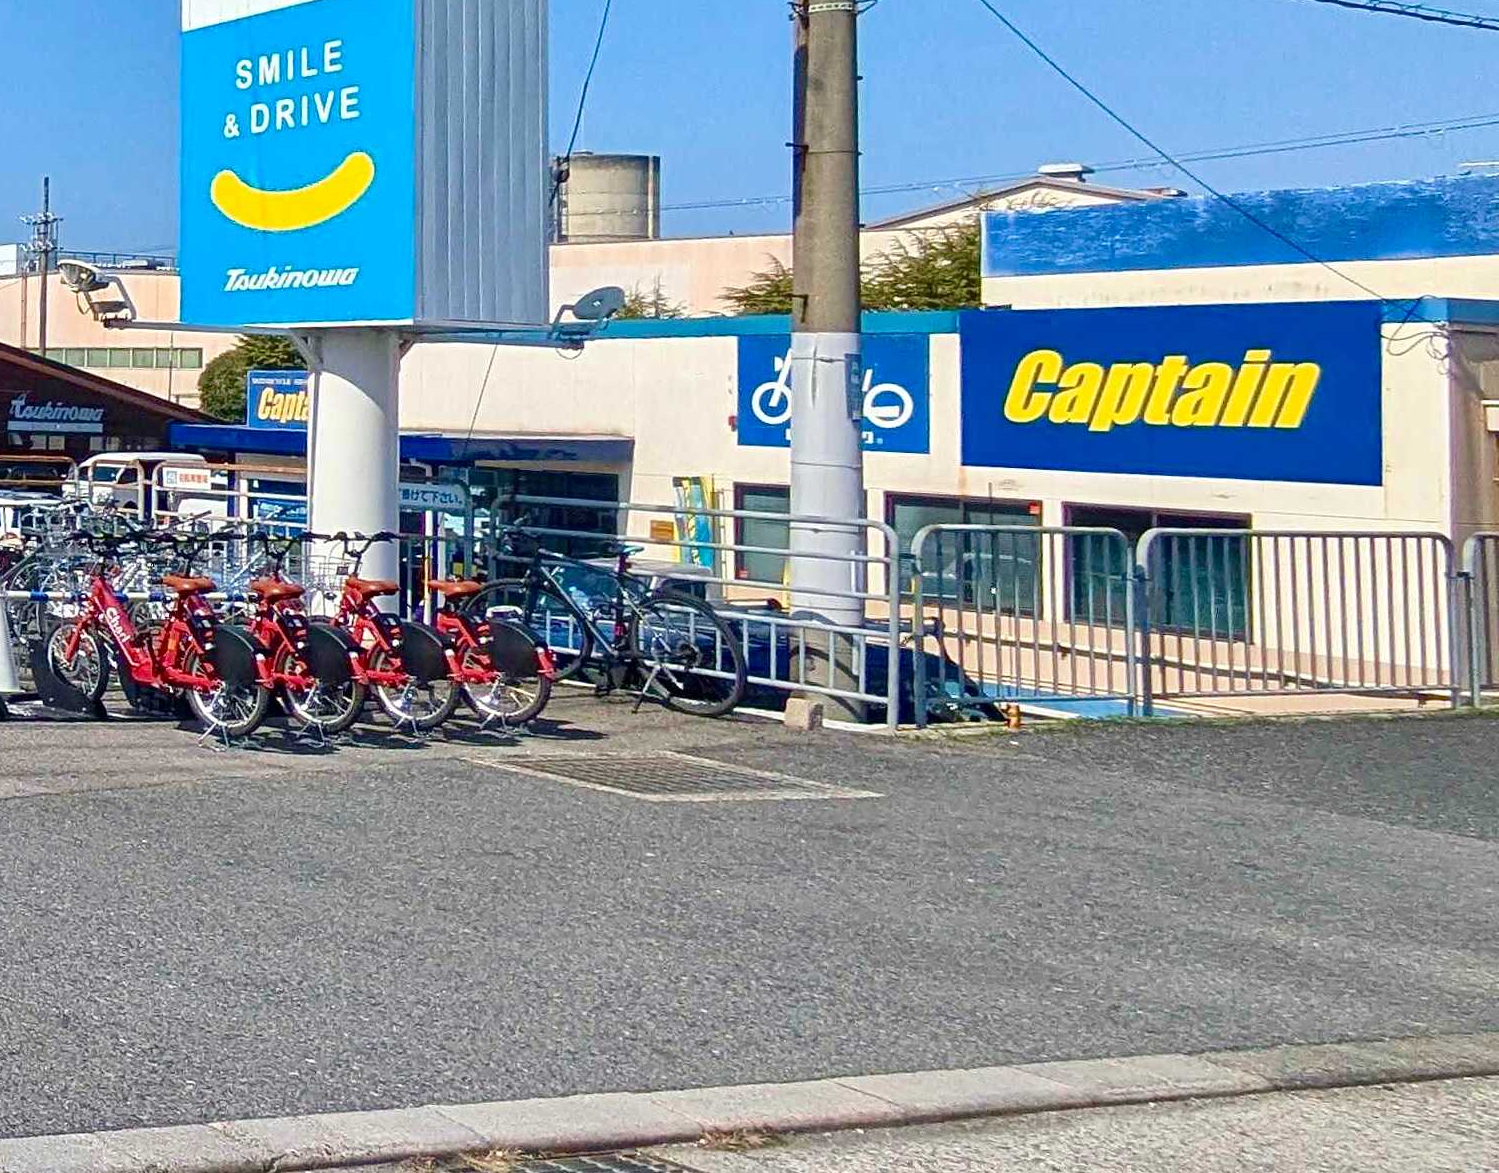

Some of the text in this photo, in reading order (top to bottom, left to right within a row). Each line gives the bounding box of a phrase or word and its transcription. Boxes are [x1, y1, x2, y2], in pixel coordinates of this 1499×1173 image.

[235, 39, 343, 90] SMILE
[223, 85, 360, 138] & DRIVE
[224, 265, 359, 292] Tsukinowa
[10, 393, 104, 421] Tsukinowa
[1004, 349, 1321, 432] Captain
